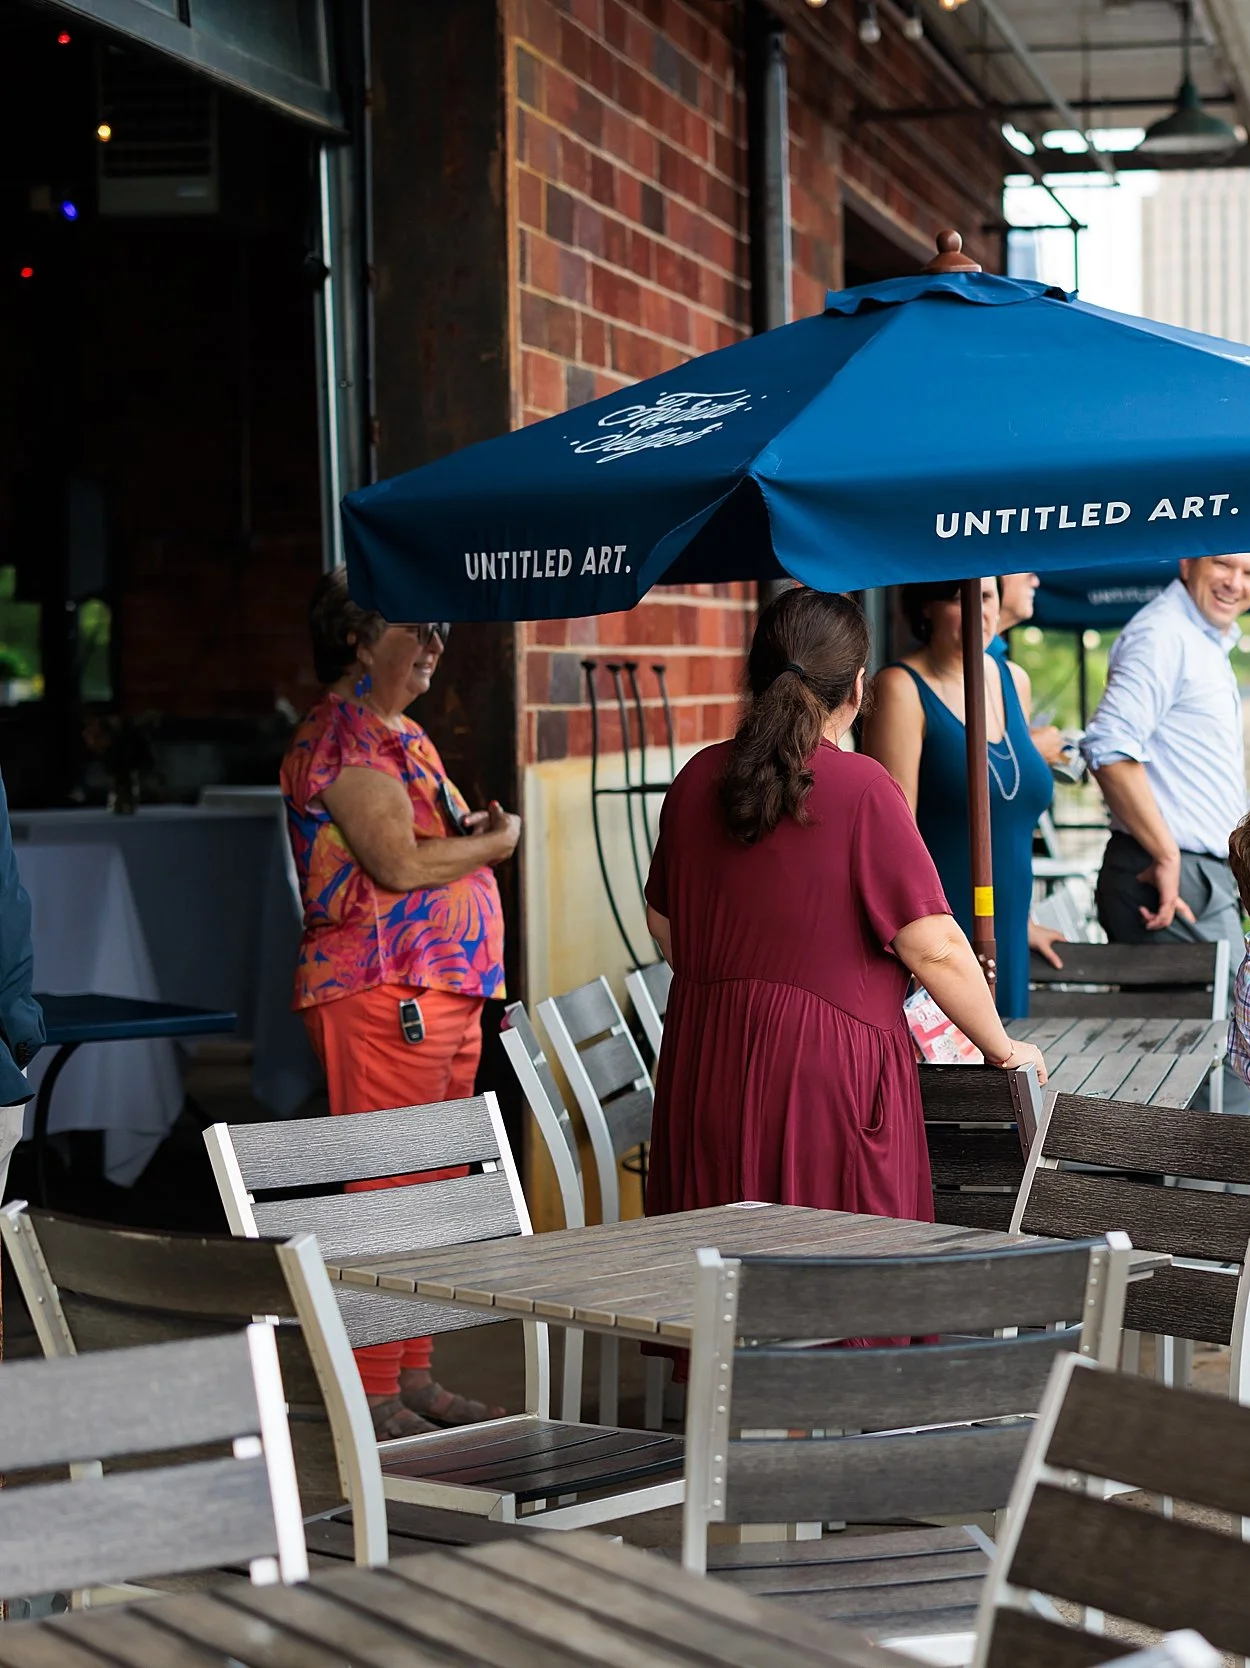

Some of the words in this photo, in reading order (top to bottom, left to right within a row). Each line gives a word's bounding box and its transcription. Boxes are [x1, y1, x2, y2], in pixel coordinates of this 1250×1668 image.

[935, 501, 1131, 539] UNTITLED
[1148, 493, 1240, 522] ART.
[464, 549, 573, 581] UNTITLED
[580, 545, 631, 576] ART.
